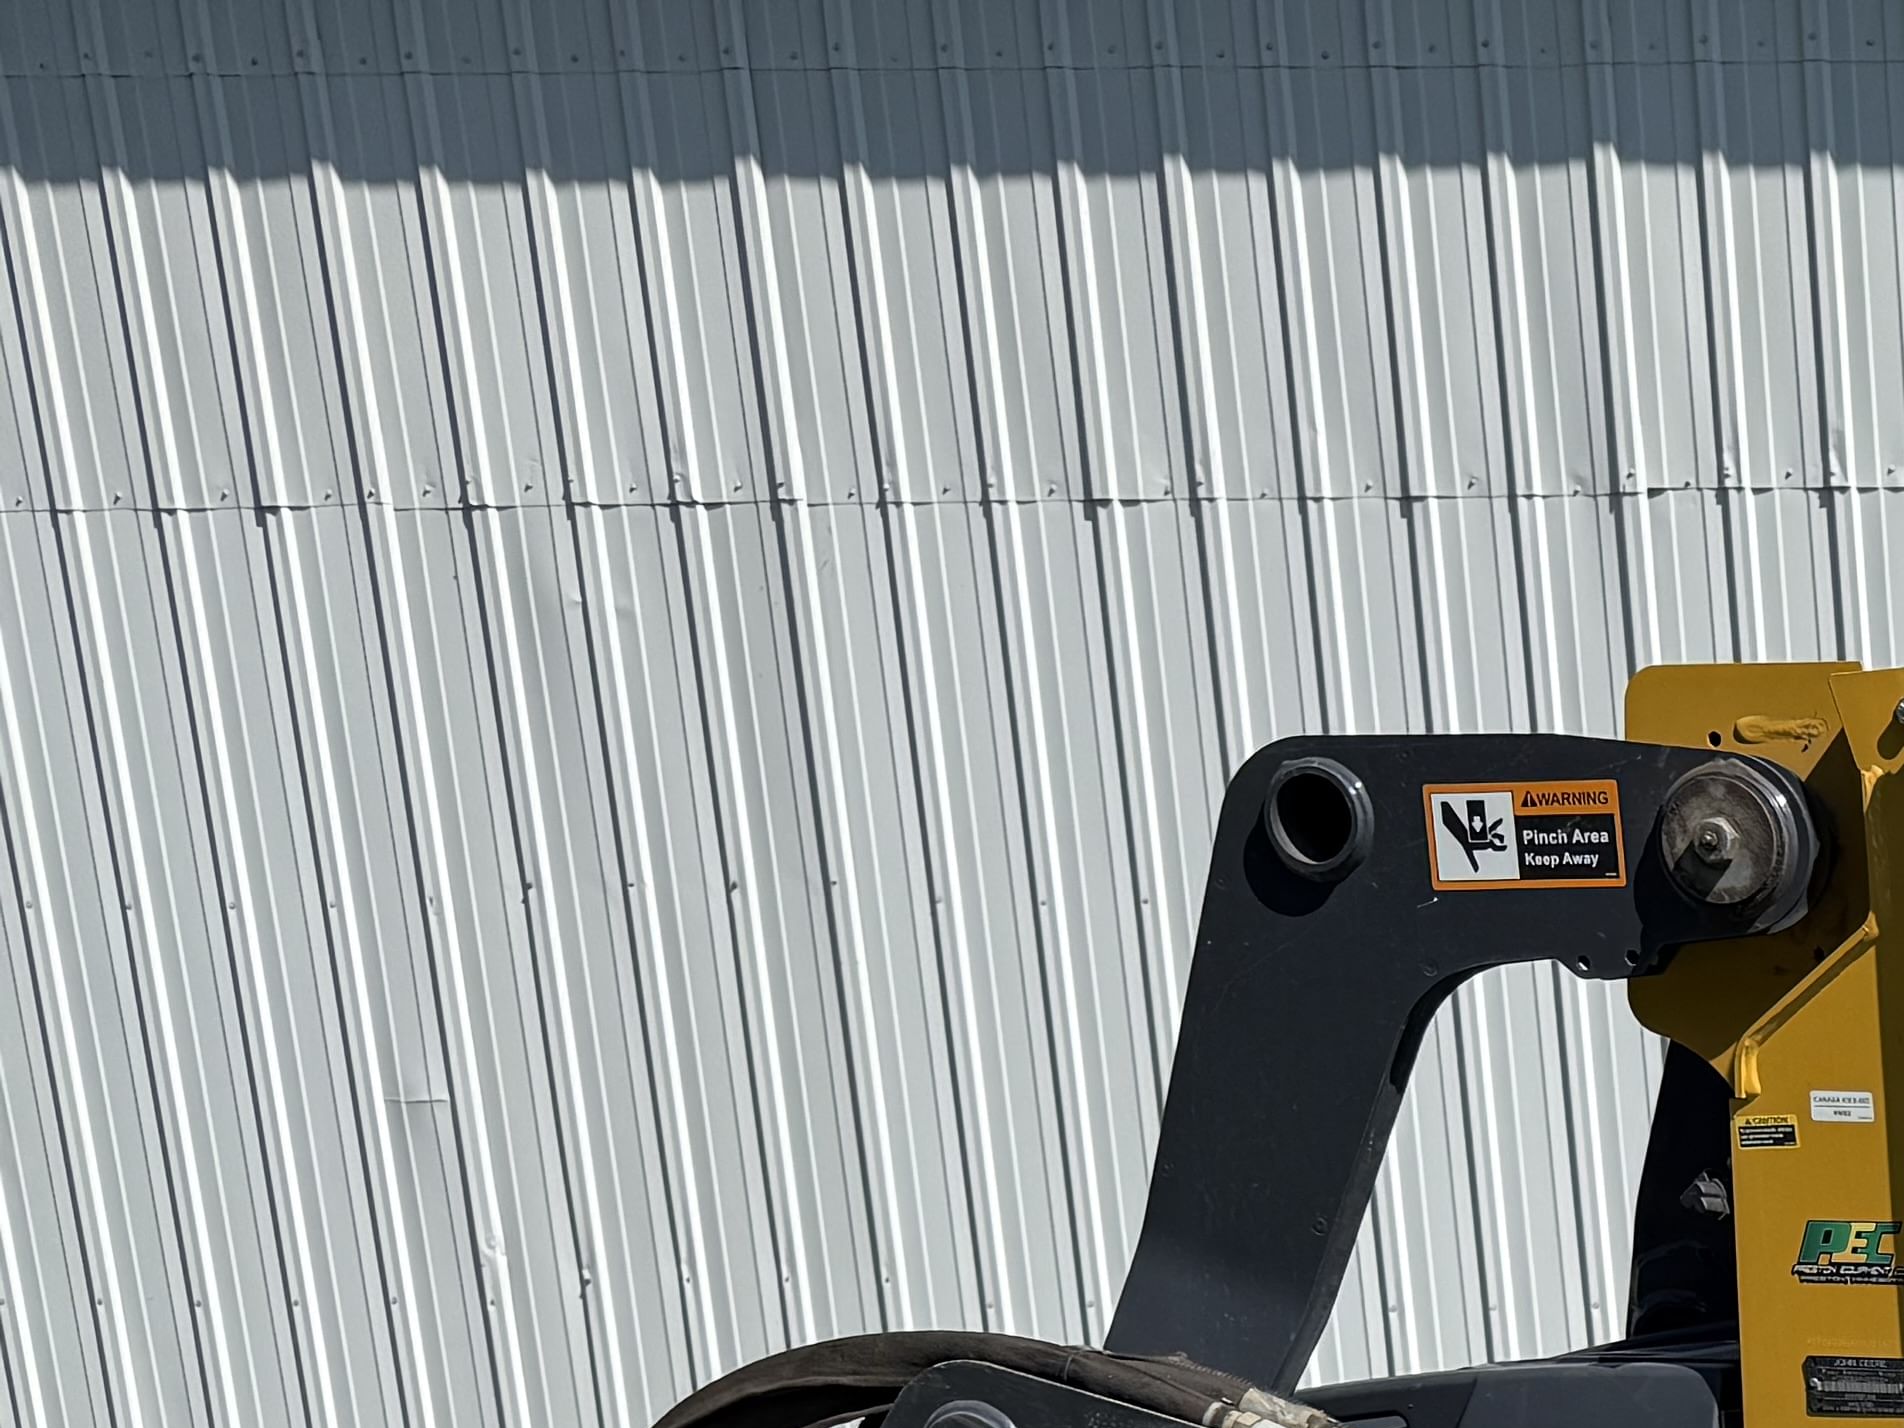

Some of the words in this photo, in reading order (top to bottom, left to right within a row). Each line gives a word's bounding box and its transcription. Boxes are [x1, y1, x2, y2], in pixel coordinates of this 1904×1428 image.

[1537, 791, 1609, 807] WARNING
[1522, 829, 1568, 845] Pinch
[1572, 828, 1610, 845] Area
[1524, 852, 1560, 869] Keep
[1562, 852, 1600, 868] Away
